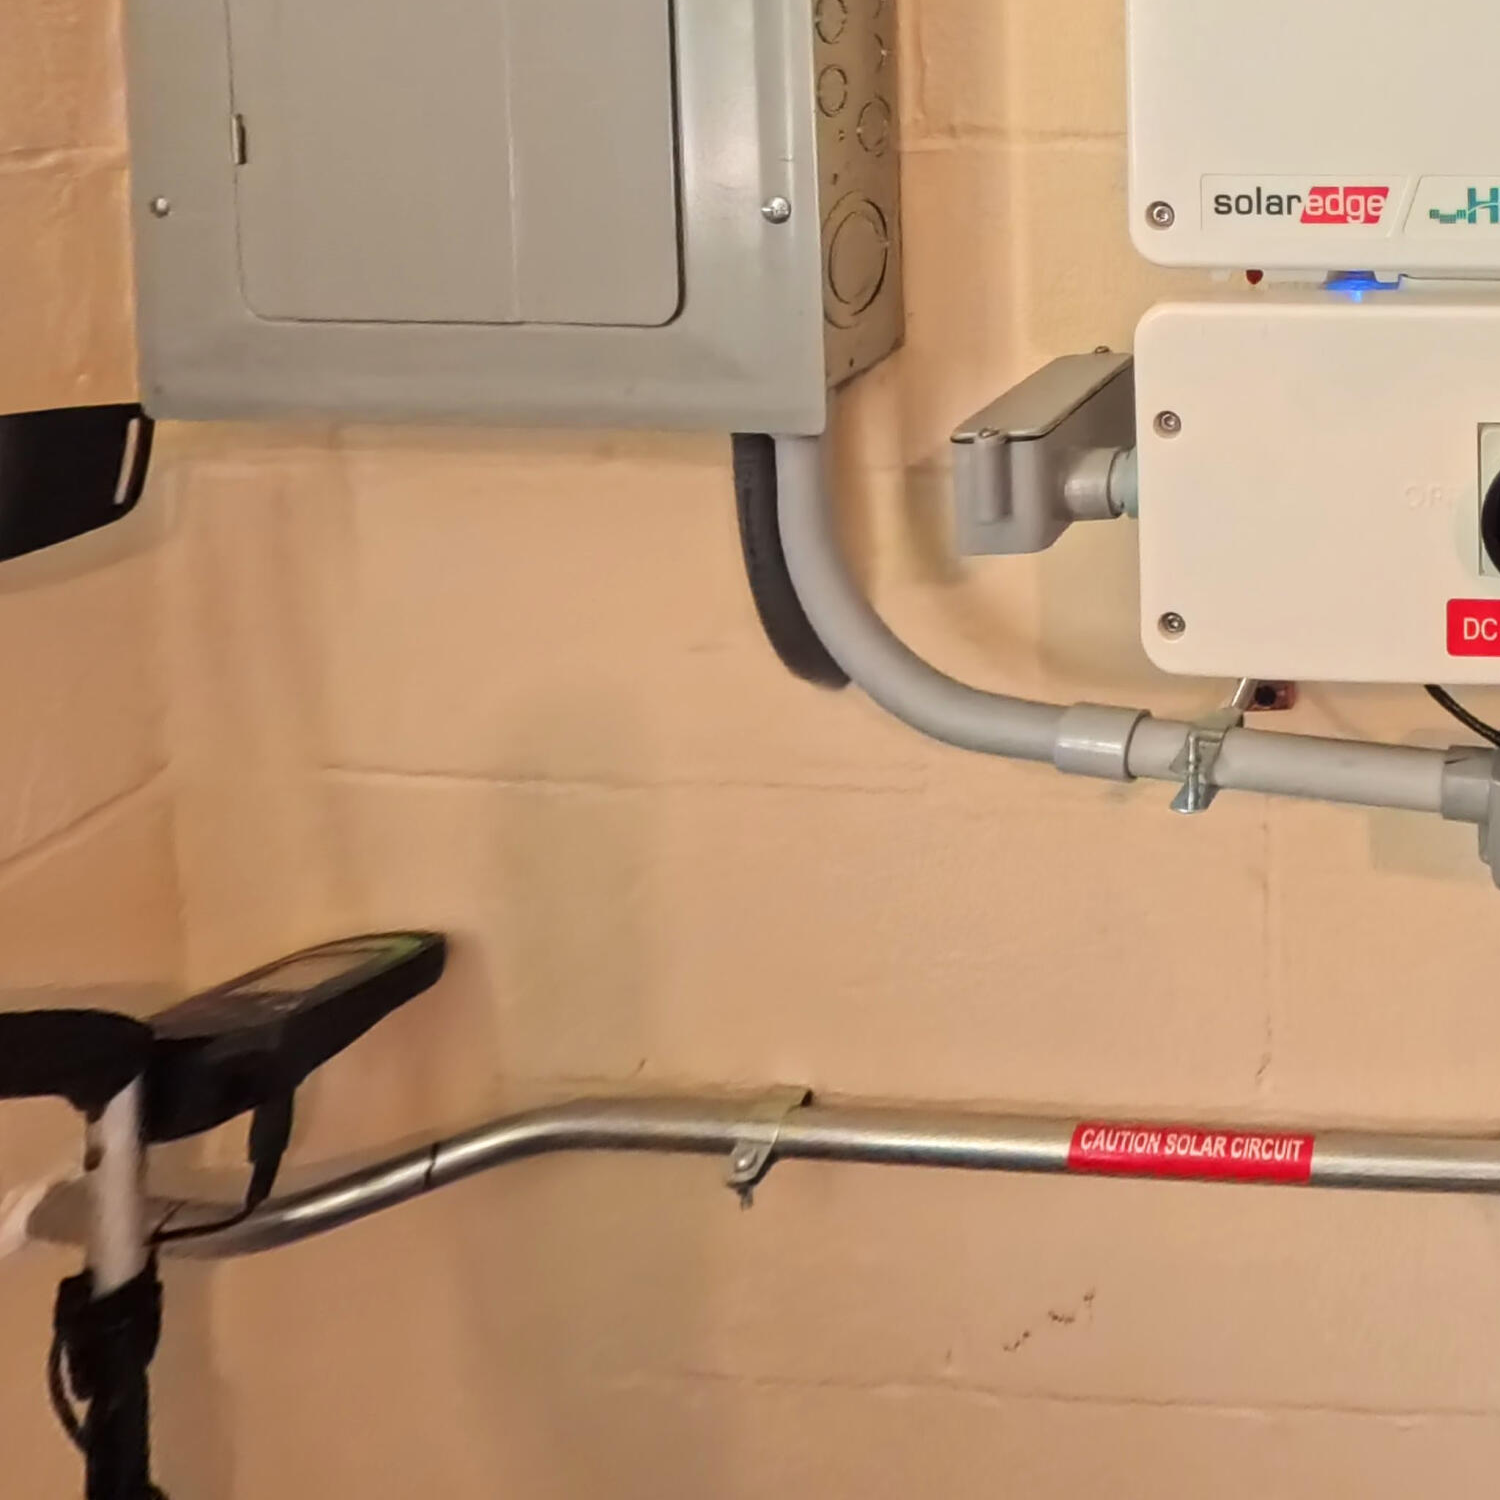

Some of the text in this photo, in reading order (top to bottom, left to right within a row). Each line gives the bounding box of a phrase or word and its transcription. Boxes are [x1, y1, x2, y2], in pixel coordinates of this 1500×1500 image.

[1463, 617, 1498, 641] DC
[1080, 1128, 1304, 1161] CAUTION SOLAR CIRCUIT
